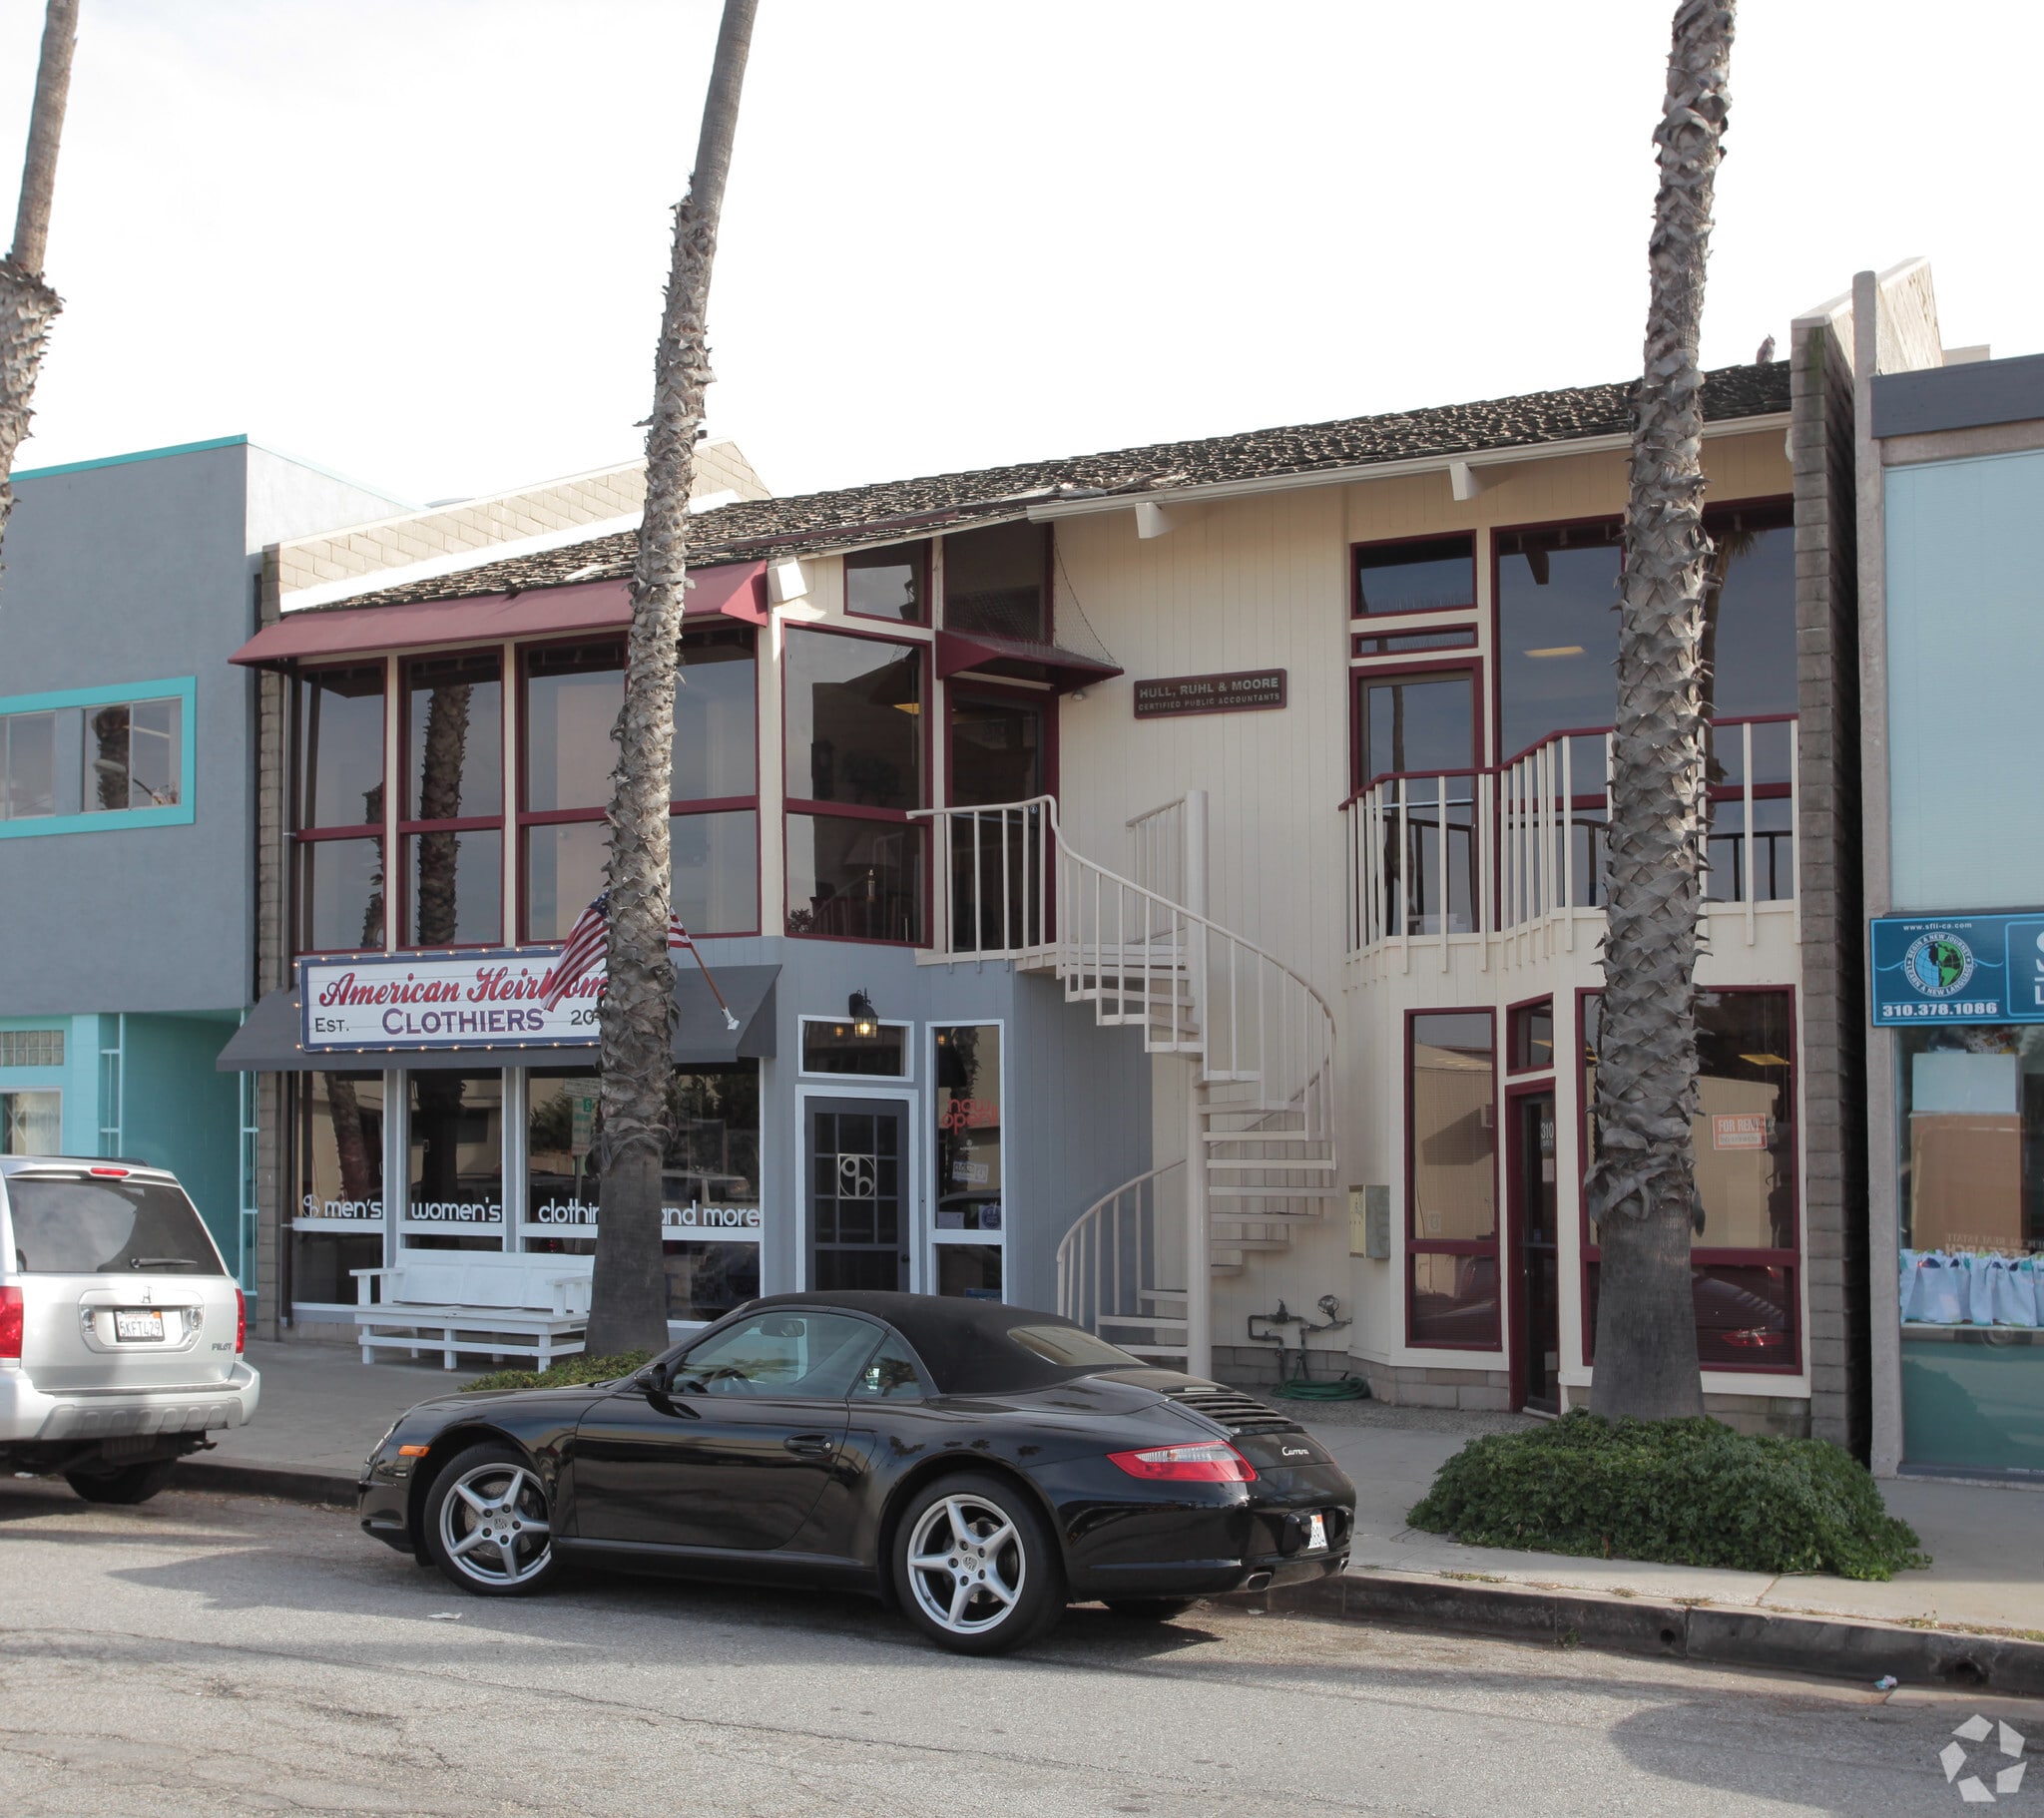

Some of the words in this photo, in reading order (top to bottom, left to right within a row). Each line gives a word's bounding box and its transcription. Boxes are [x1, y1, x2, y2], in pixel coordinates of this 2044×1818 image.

[1180, 683, 1215, 695] RUHL
[1218, 682, 1228, 692] &
[1232, 678, 1278, 690] MOORE
[1138, 700, 1181, 711] CERTIFIED
[1184, 697, 1215, 707] PUBLIC
[1218, 692, 1280, 704] ACCOUNTANTS
[1907, 940, 1923, 959] BEGIN
[1946, 935, 1971, 956] JOURNEY
[318, 972, 460, 1007] American
[466, 966, 609, 1003] Heirlom
[1906, 965, 1921, 987] LEARN
[1945, 963, 1972, 993] LANGUAGE
[1882, 1002, 1997, 1017] 310.378.1086
[314, 1017, 349, 1033] EST.
[381, 1007, 545, 1036] CLOTHIERS
[948, 1099, 991, 1114] now
[1540, 1122, 1555, 1139] 310
[1718, 1119, 1735, 1133] FOR
[1738, 1118, 1760, 1133] RENT
[324, 1198, 383, 1218] men's
[411, 1196, 501, 1222] women's
[703, 1206, 761, 1226] more
[211, 1342, 233, 1351] PILOT
